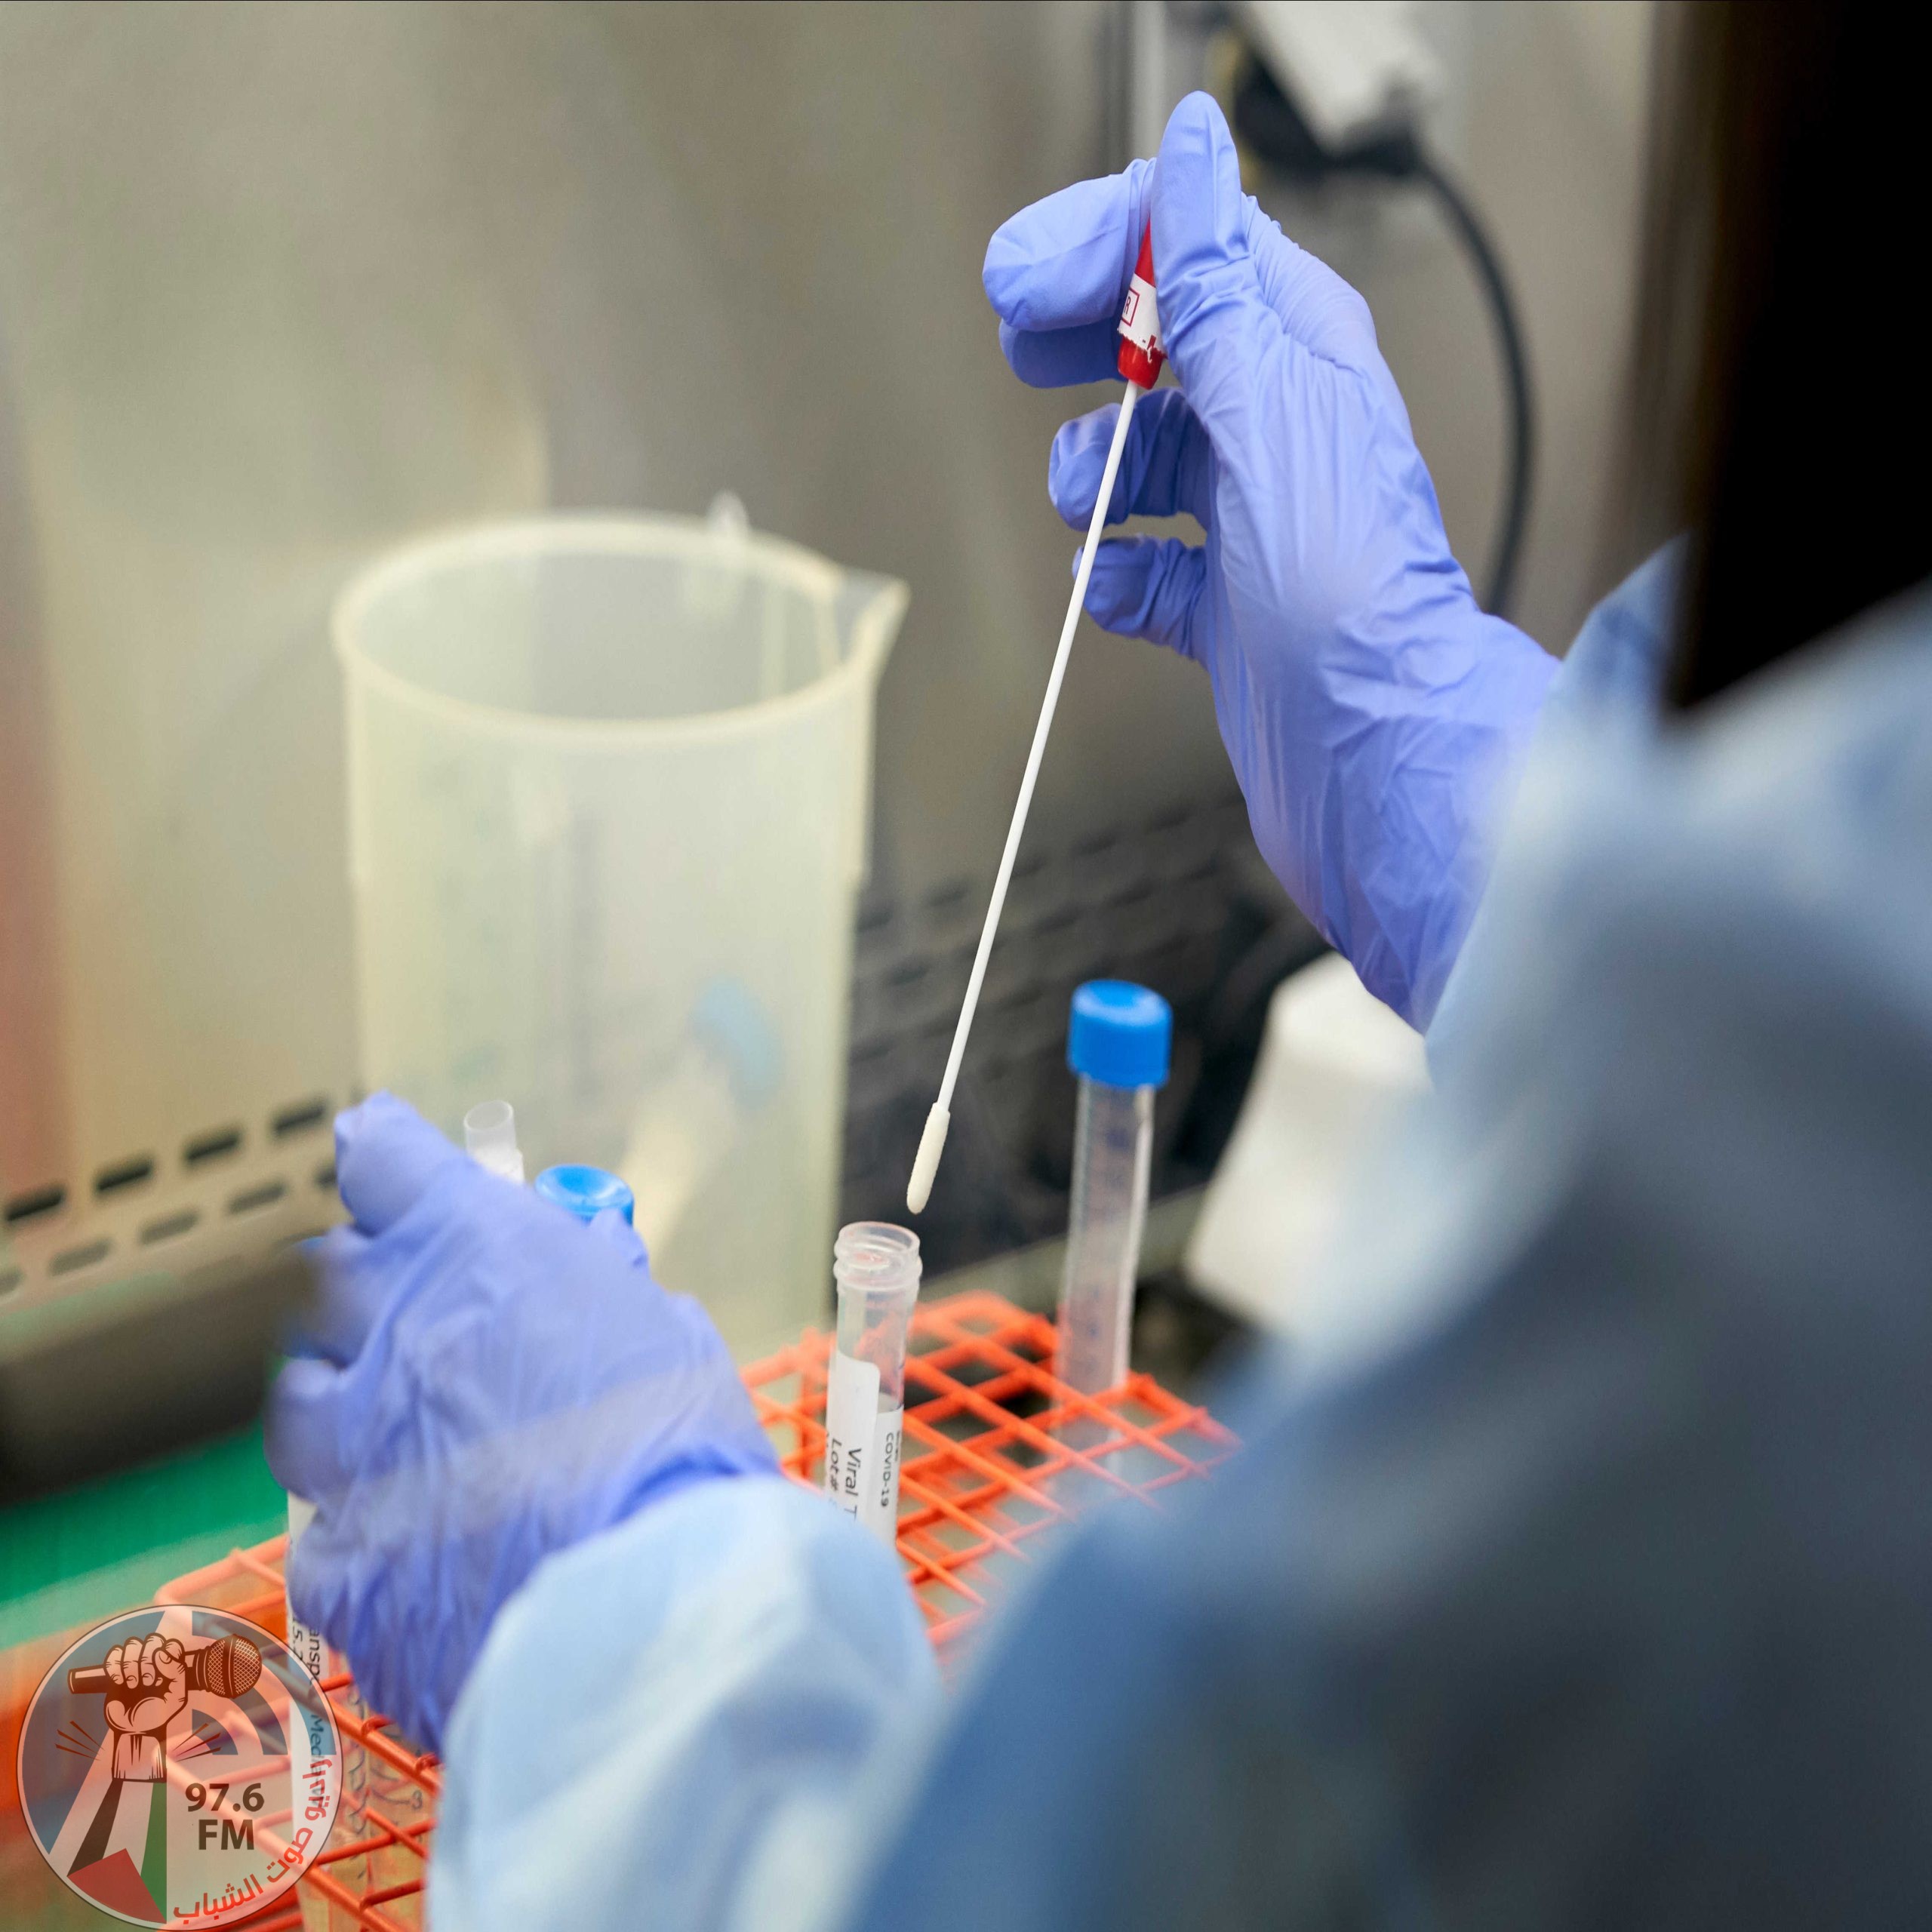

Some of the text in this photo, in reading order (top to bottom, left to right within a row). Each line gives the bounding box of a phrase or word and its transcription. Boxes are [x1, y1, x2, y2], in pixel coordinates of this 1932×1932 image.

[830, 1438, 842, 1492] Lot#
[844, 1447, 862, 1521] Viral T
[881, 1432, 894, 1507] COVID-19
